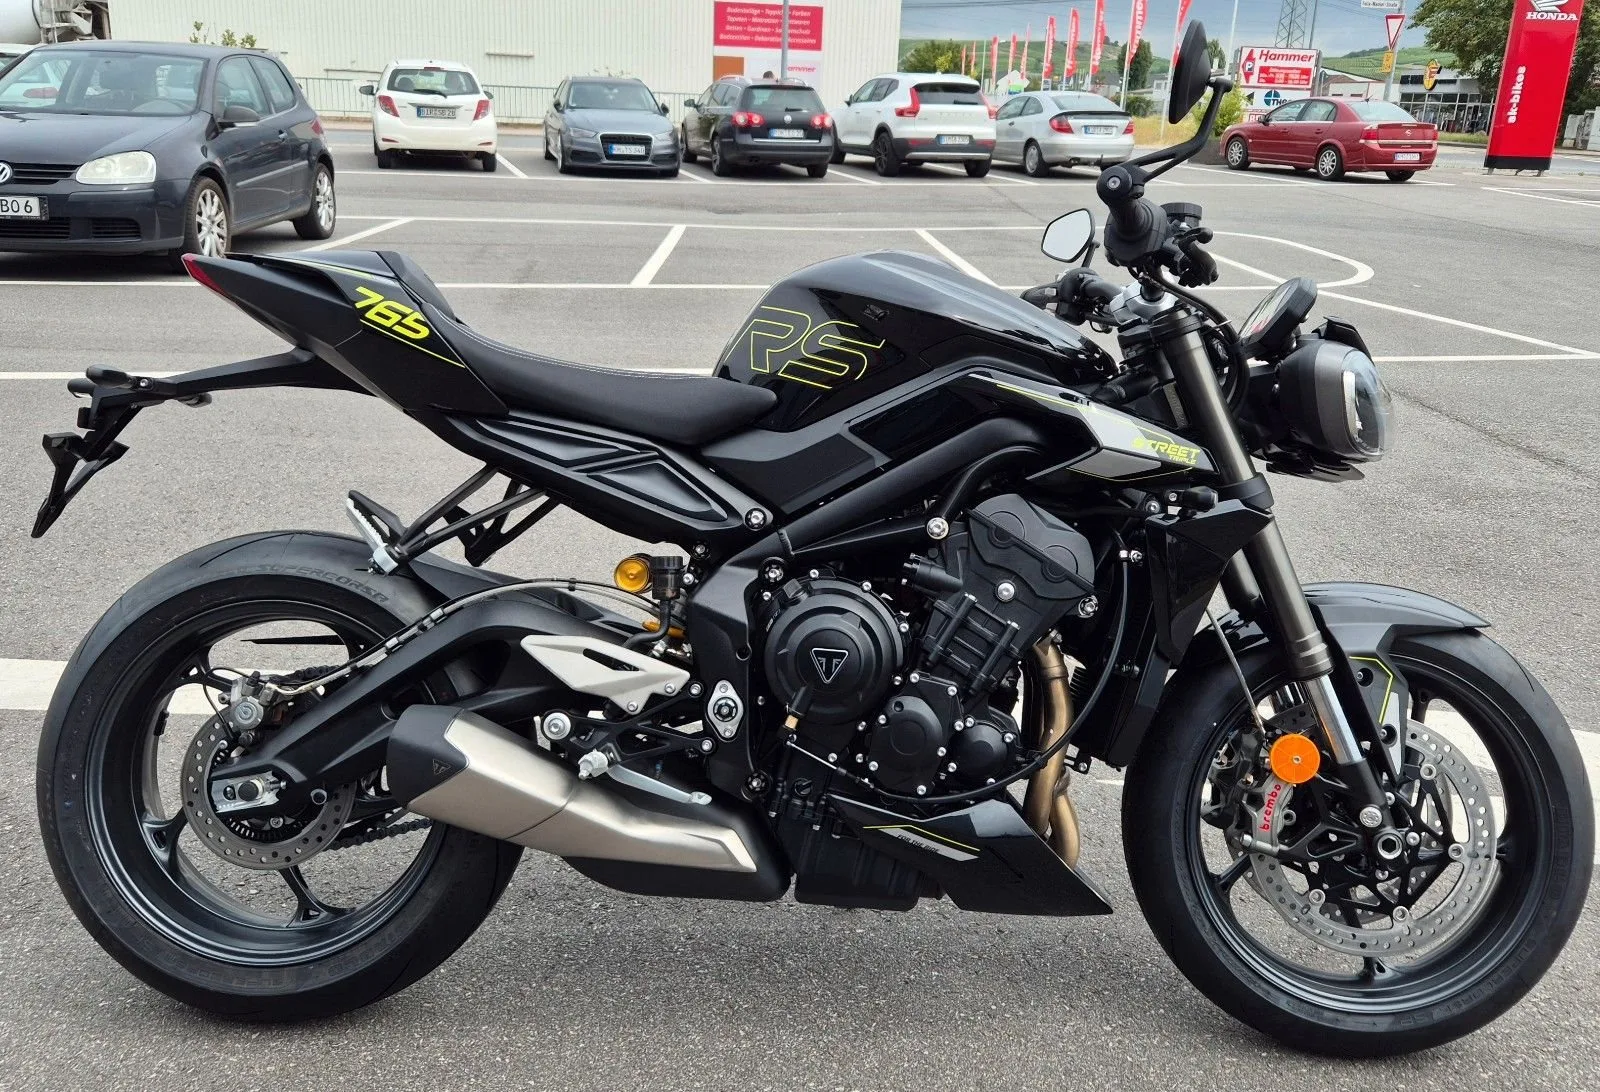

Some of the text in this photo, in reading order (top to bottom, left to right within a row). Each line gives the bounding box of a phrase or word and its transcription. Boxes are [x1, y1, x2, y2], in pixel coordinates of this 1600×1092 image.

[1526, 11, 1579, 21] HONDA
[787, 65, 816, 73] ammer
[1259, 49, 1315, 63] Hammer
[1507, 65, 1527, 124] ak-bikes
[24, 200, 33, 214] 6
[355, 286, 430, 339] 765
[724, 305, 886, 389] RS
[1132, 438, 1200, 459] STREET
[259, 563, 390, 603] SUPERCORSA
[1259, 784, 1281, 830] brembo
